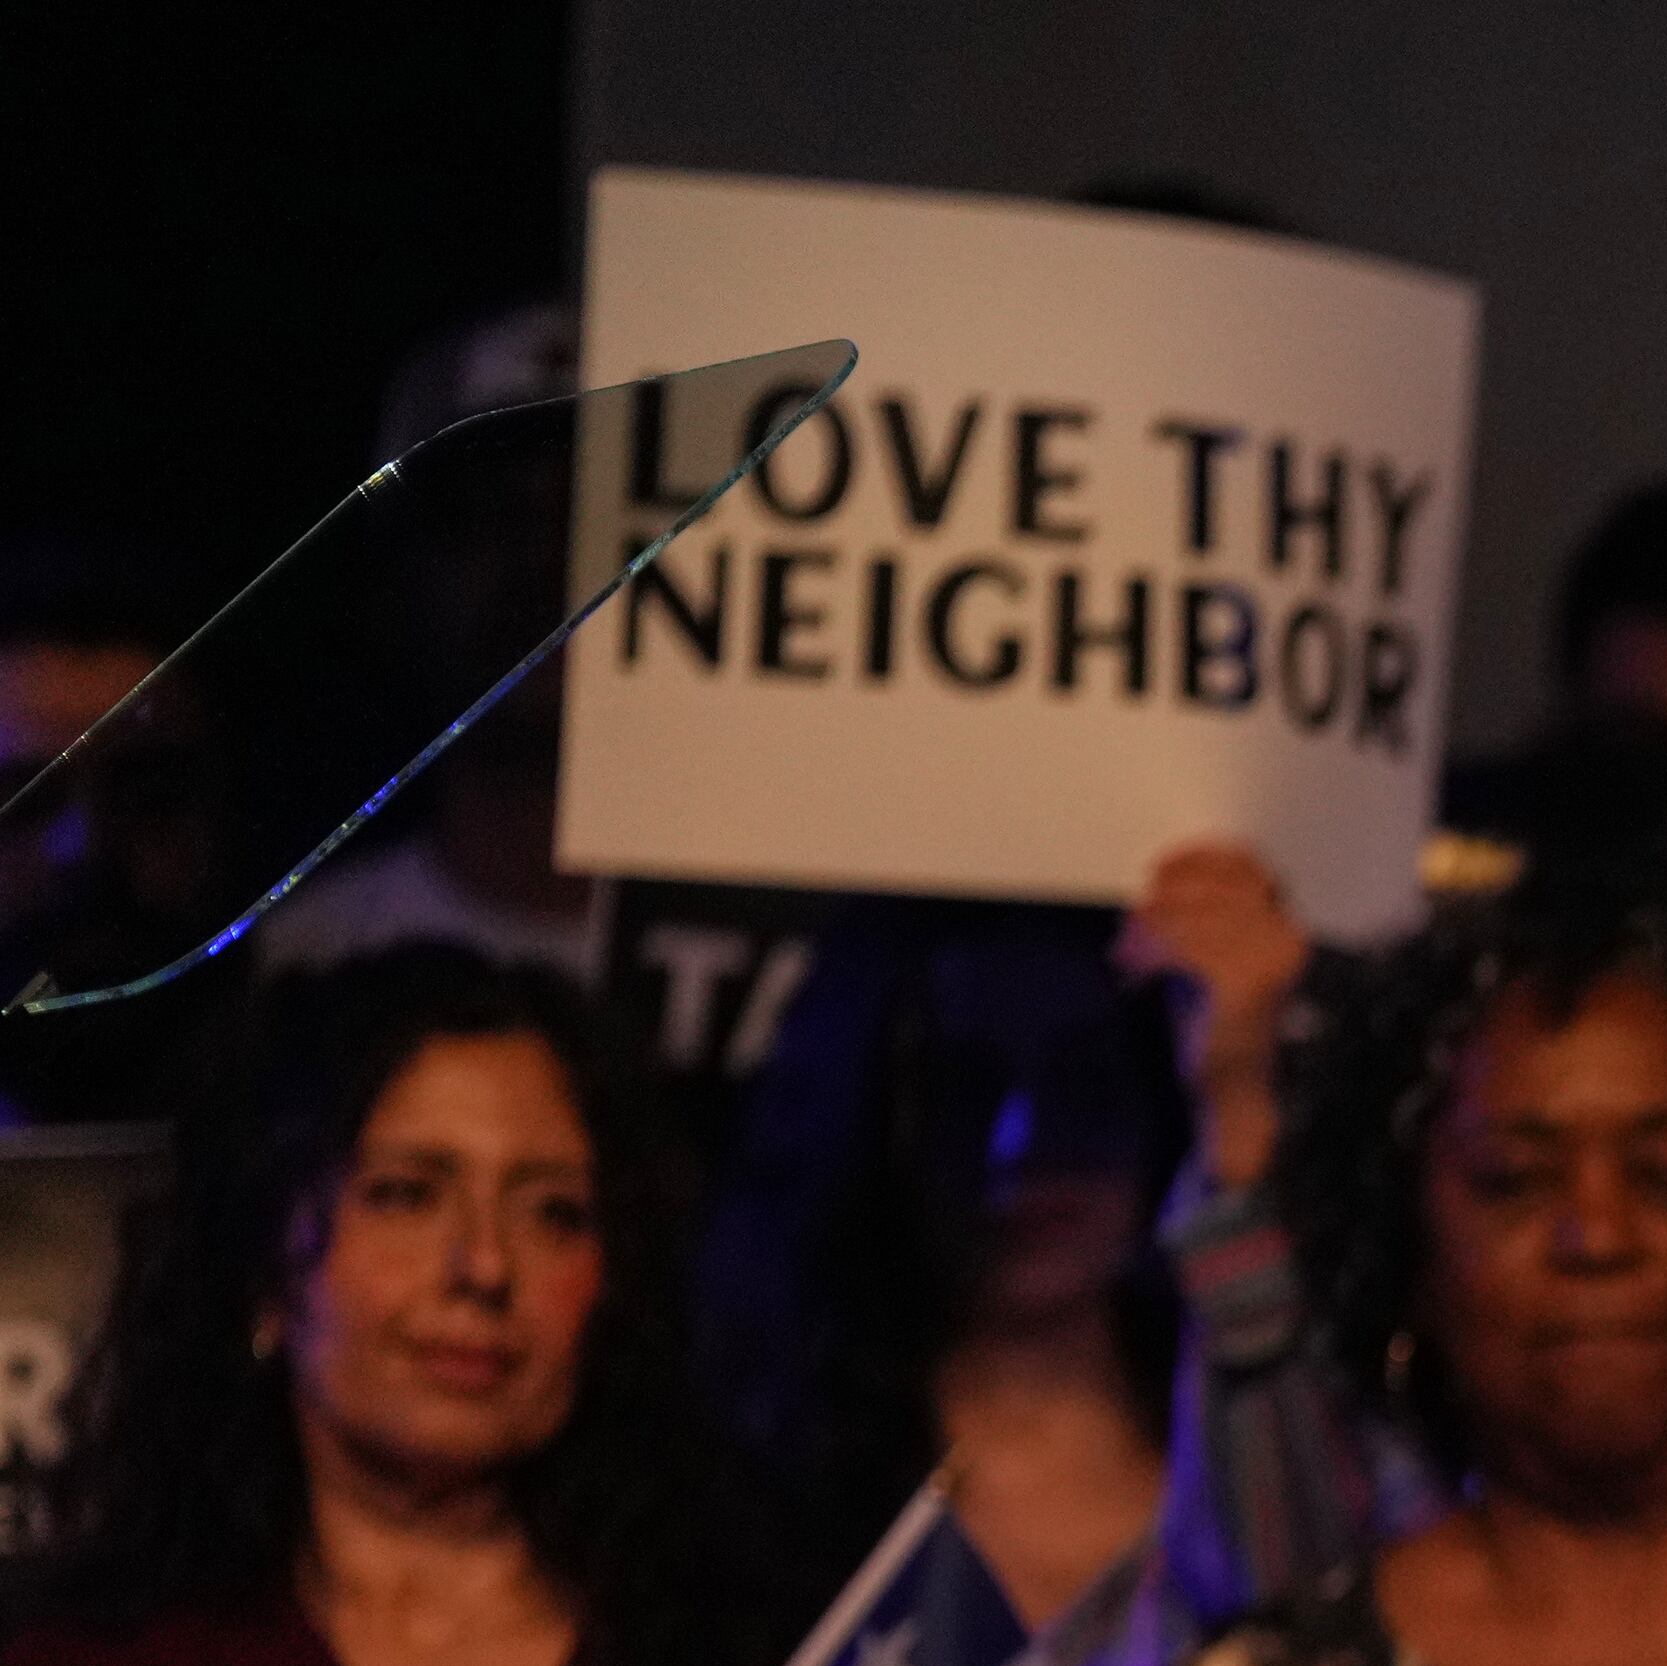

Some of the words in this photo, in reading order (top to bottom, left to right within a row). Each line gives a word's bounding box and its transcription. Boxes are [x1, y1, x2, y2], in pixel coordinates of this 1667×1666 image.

[622, 374, 1096, 544] LOVE
[1150, 418, 1434, 602] THY
[617, 538, 1424, 757] NEIGHBOR
